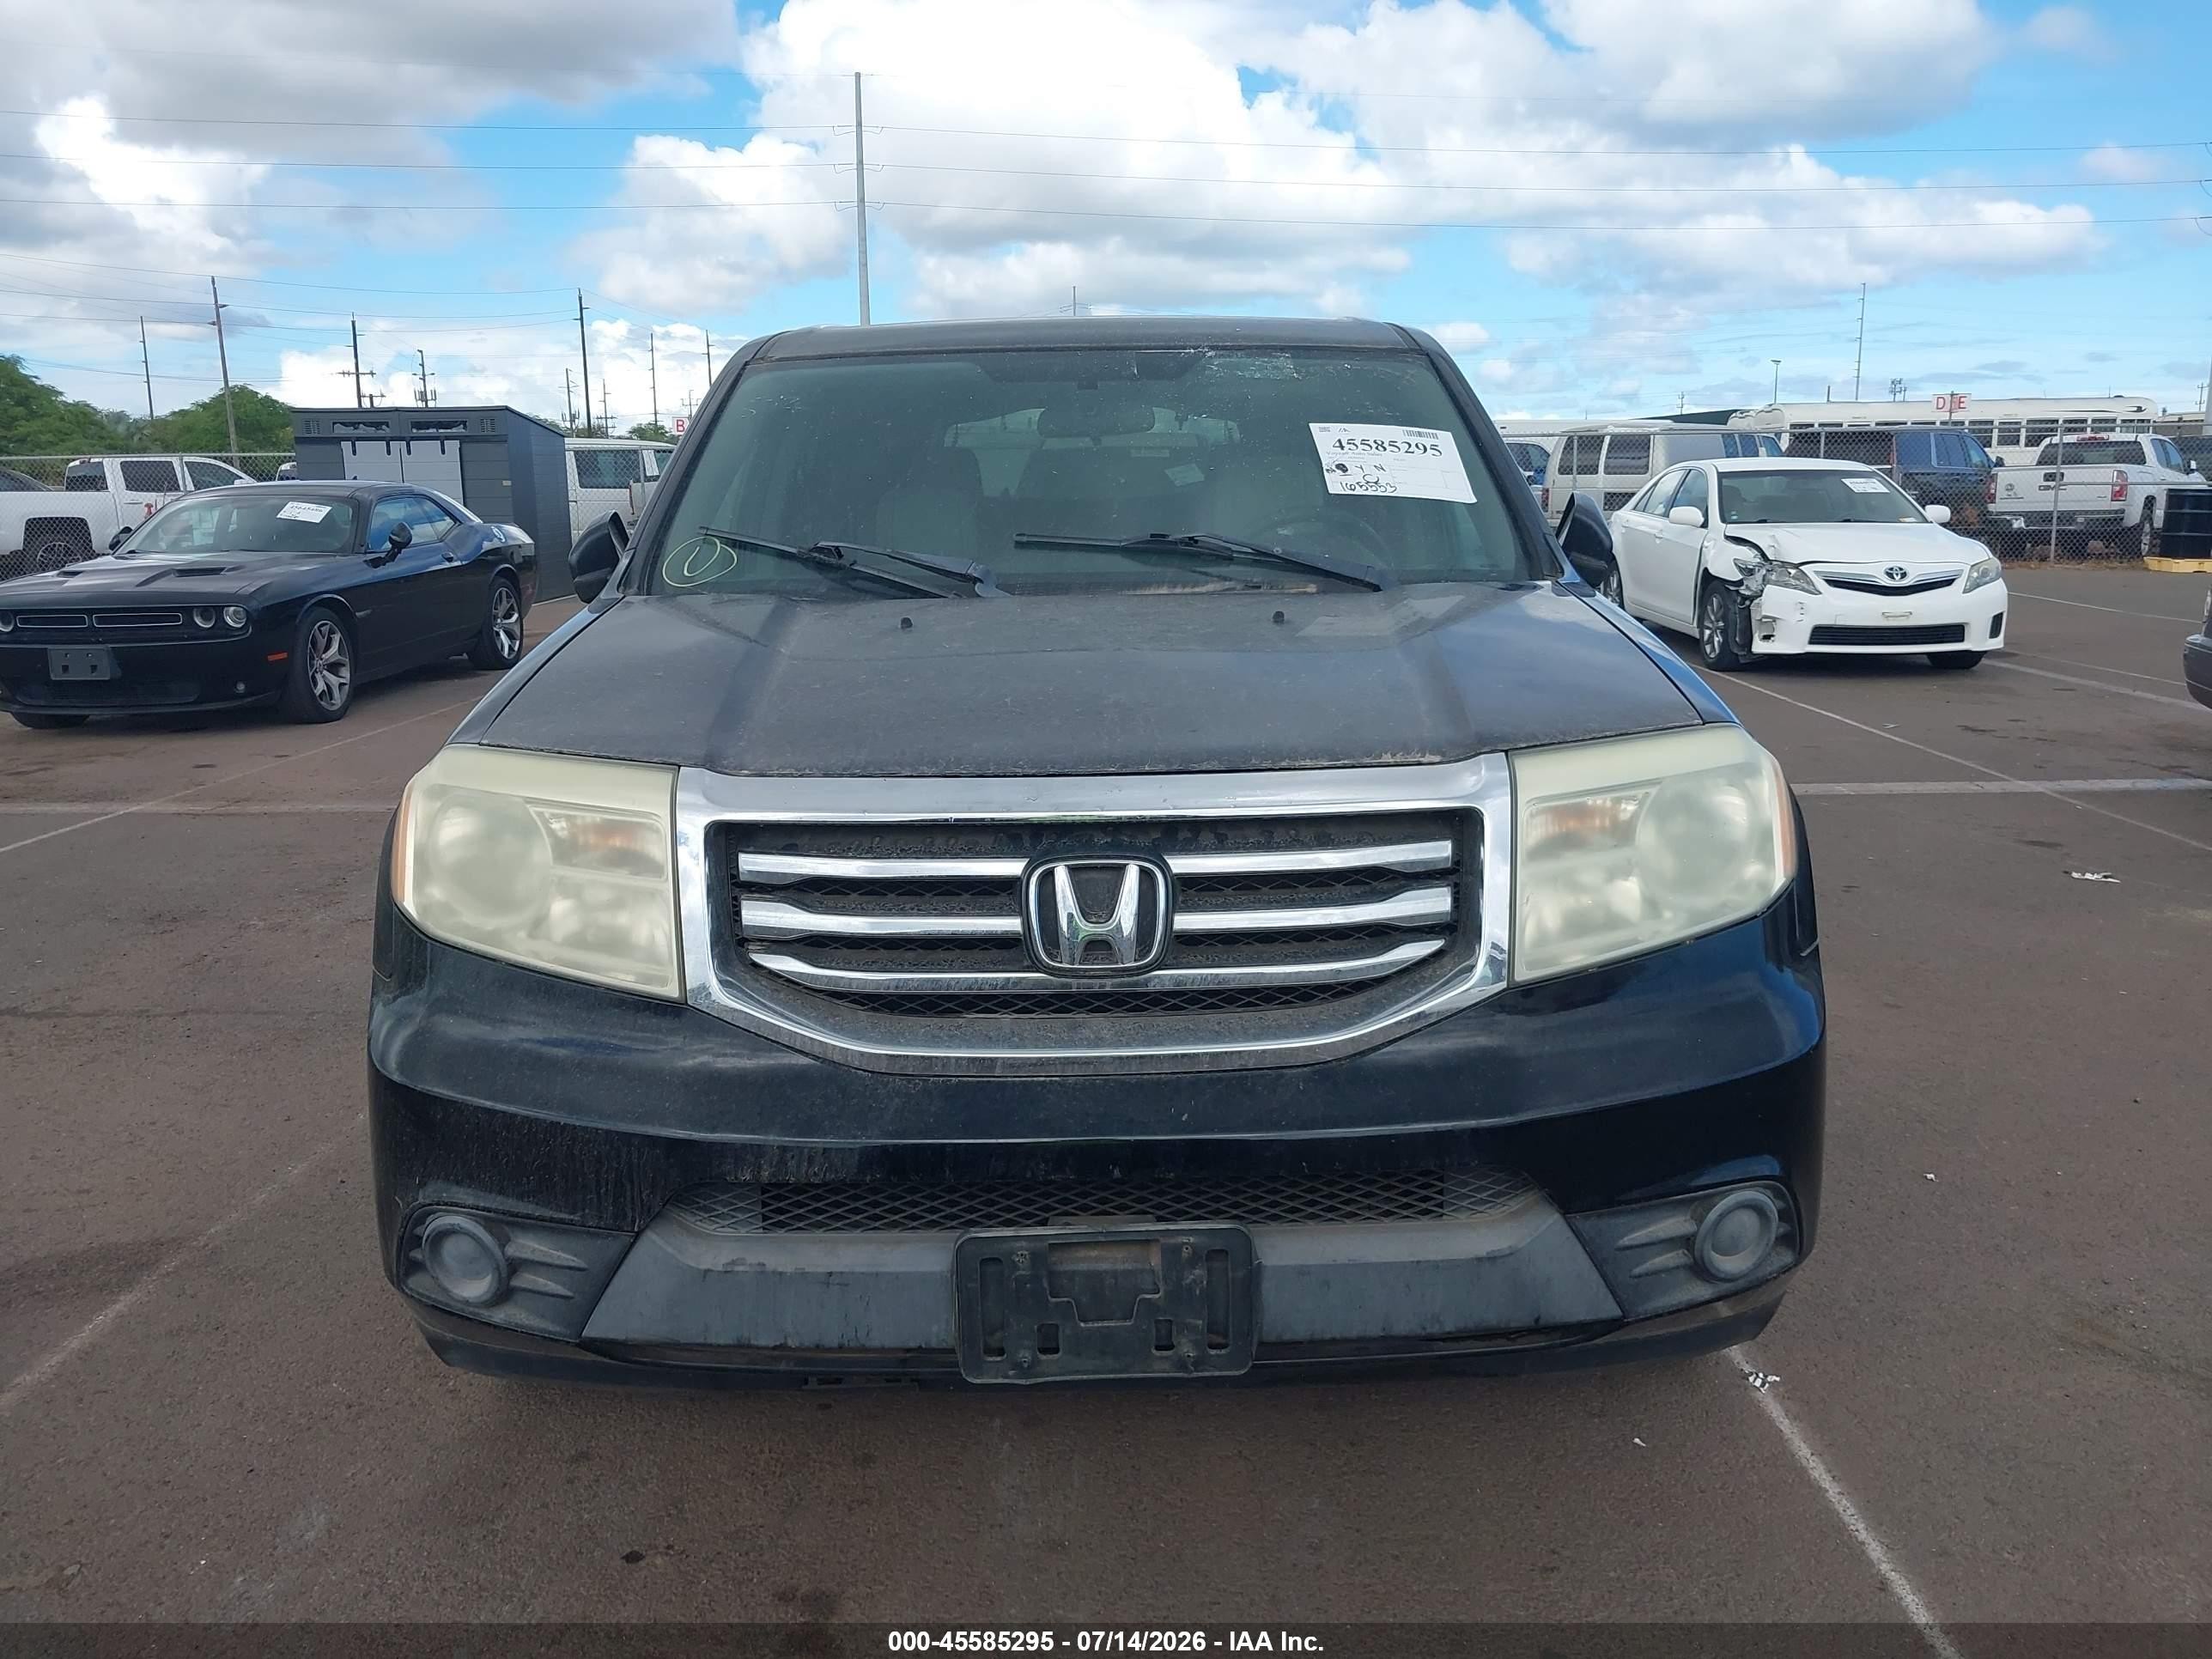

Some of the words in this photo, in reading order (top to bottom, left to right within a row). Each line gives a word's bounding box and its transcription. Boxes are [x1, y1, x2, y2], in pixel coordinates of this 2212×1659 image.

[1936, 396, 1946, 410] D
[676, 419, 685, 433] B
[1332, 437, 1443, 457] 45585295
